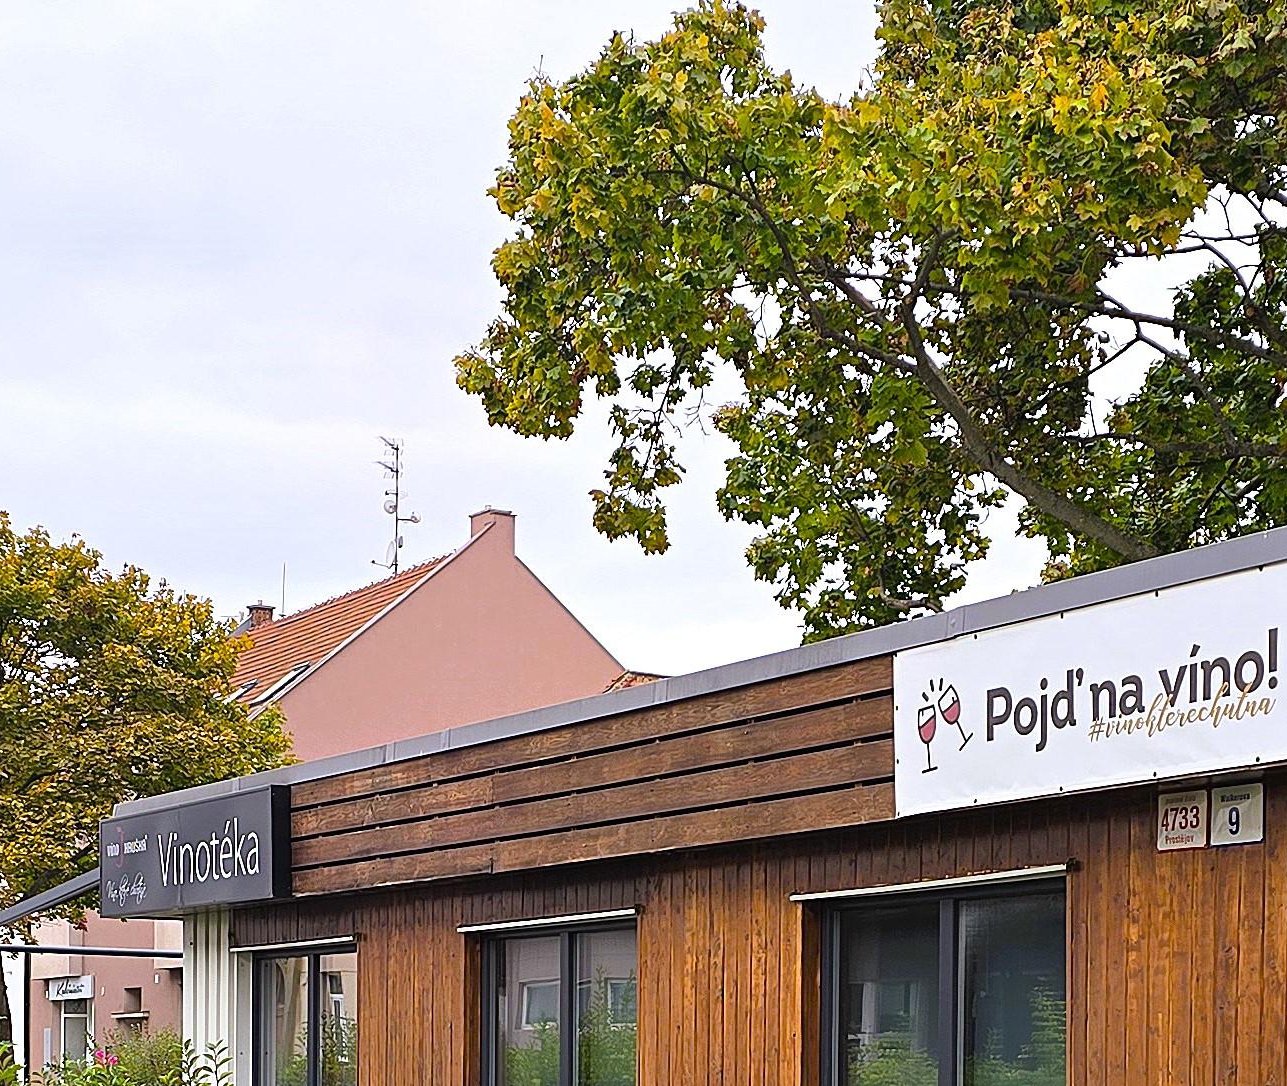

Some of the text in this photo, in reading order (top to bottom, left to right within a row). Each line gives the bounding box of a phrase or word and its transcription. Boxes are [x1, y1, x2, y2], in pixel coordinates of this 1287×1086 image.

[986, 627, 1279, 752] Pojď na víno!
[1161, 805, 1200, 832] 4733
[1228, 806, 1240, 835] 9
[157, 818, 260, 887] Vinotéka
